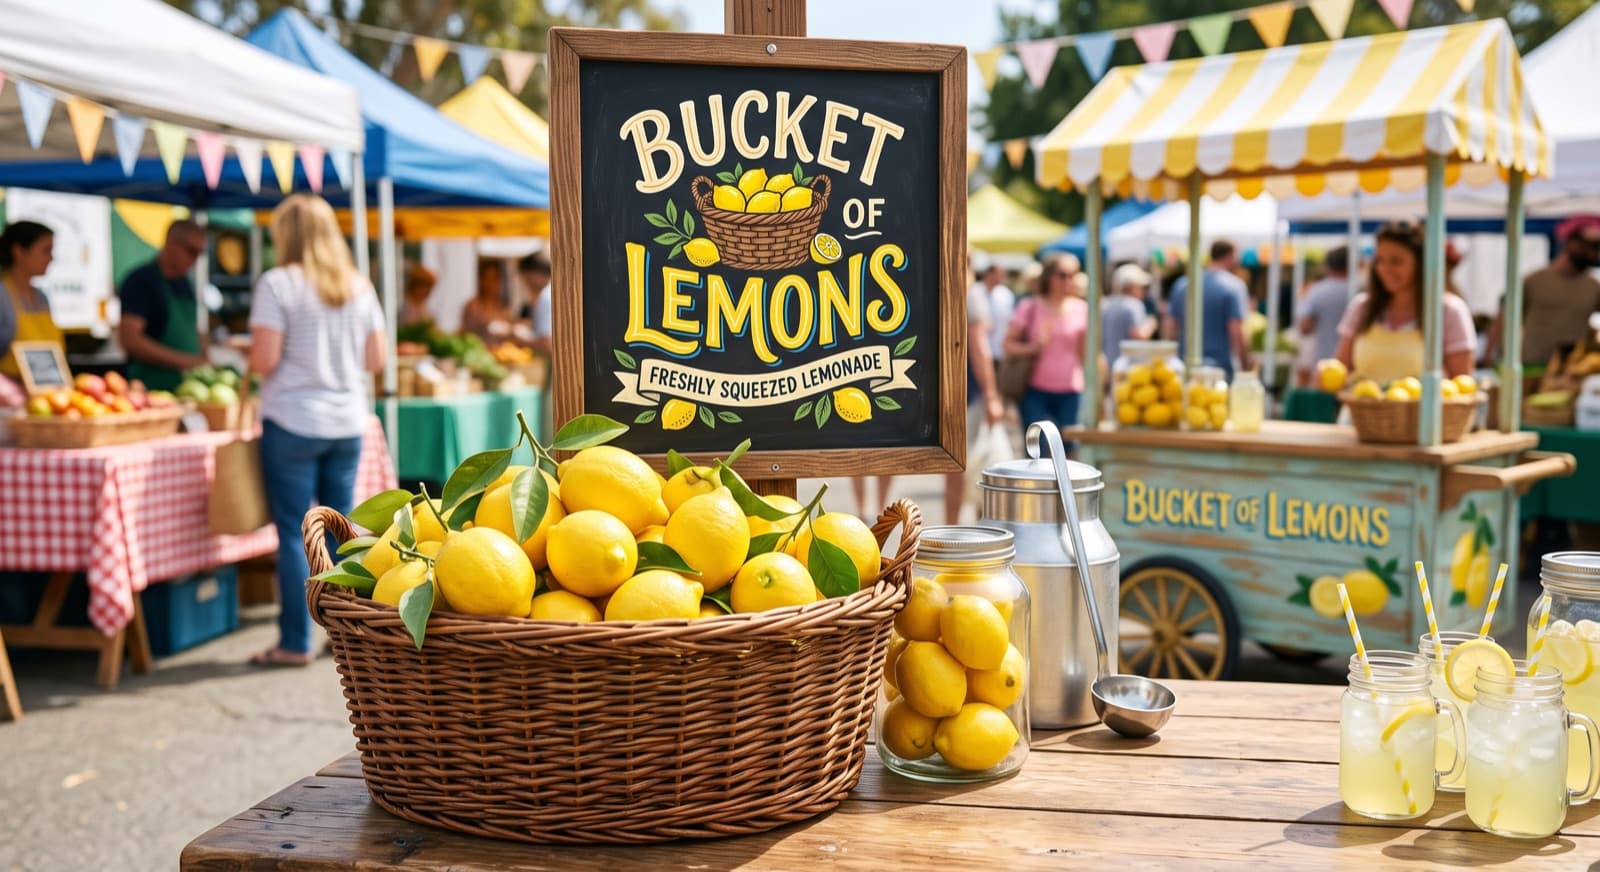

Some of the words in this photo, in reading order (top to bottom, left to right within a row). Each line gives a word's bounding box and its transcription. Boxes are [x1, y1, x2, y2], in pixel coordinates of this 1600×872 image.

[620, 90, 904, 193] BUCKET
[842, 198, 885, 229] OF
[624, 241, 910, 366] LEMONS
[650, 366, 715, 396] FRESHLY
[720, 376, 797, 401] SQUEEZED
[802, 352, 882, 389] LEMONADE
[1124, 479, 1232, 528] BUCKET
[1236, 499, 1260, 524] OF
[1266, 491, 1390, 546] LEMONS
